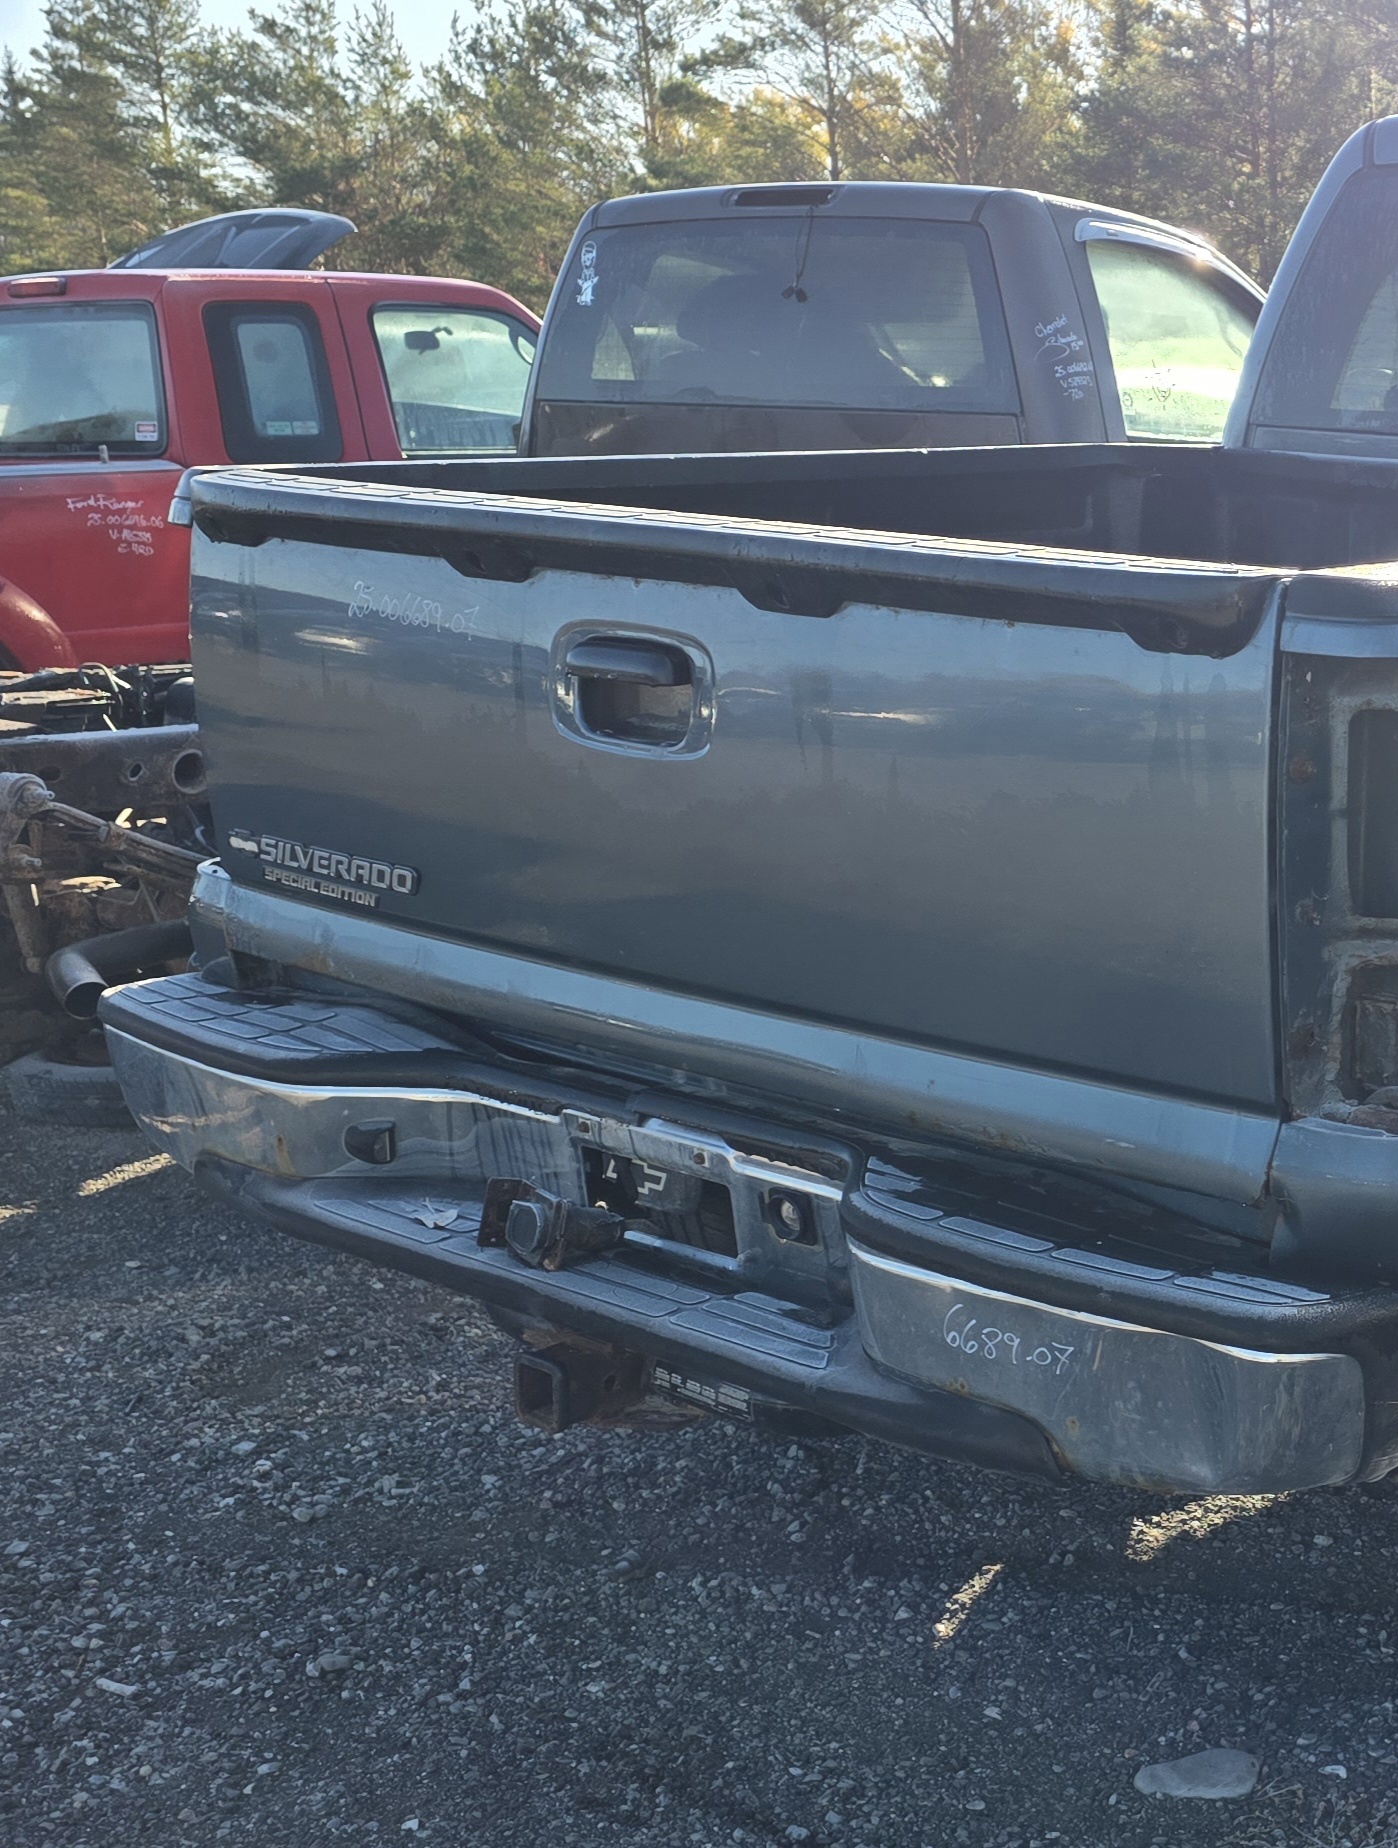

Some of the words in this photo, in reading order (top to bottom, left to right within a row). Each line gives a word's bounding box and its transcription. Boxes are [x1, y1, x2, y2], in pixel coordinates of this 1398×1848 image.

[348, 580, 480, 641] 25.006689.07
[259, 837, 413, 894] SILVERADO
[265, 867, 319, 893] SPECIAL
[319, 884, 376, 907] EDITION
[943, 1303, 1075, 1375] 6689.07
